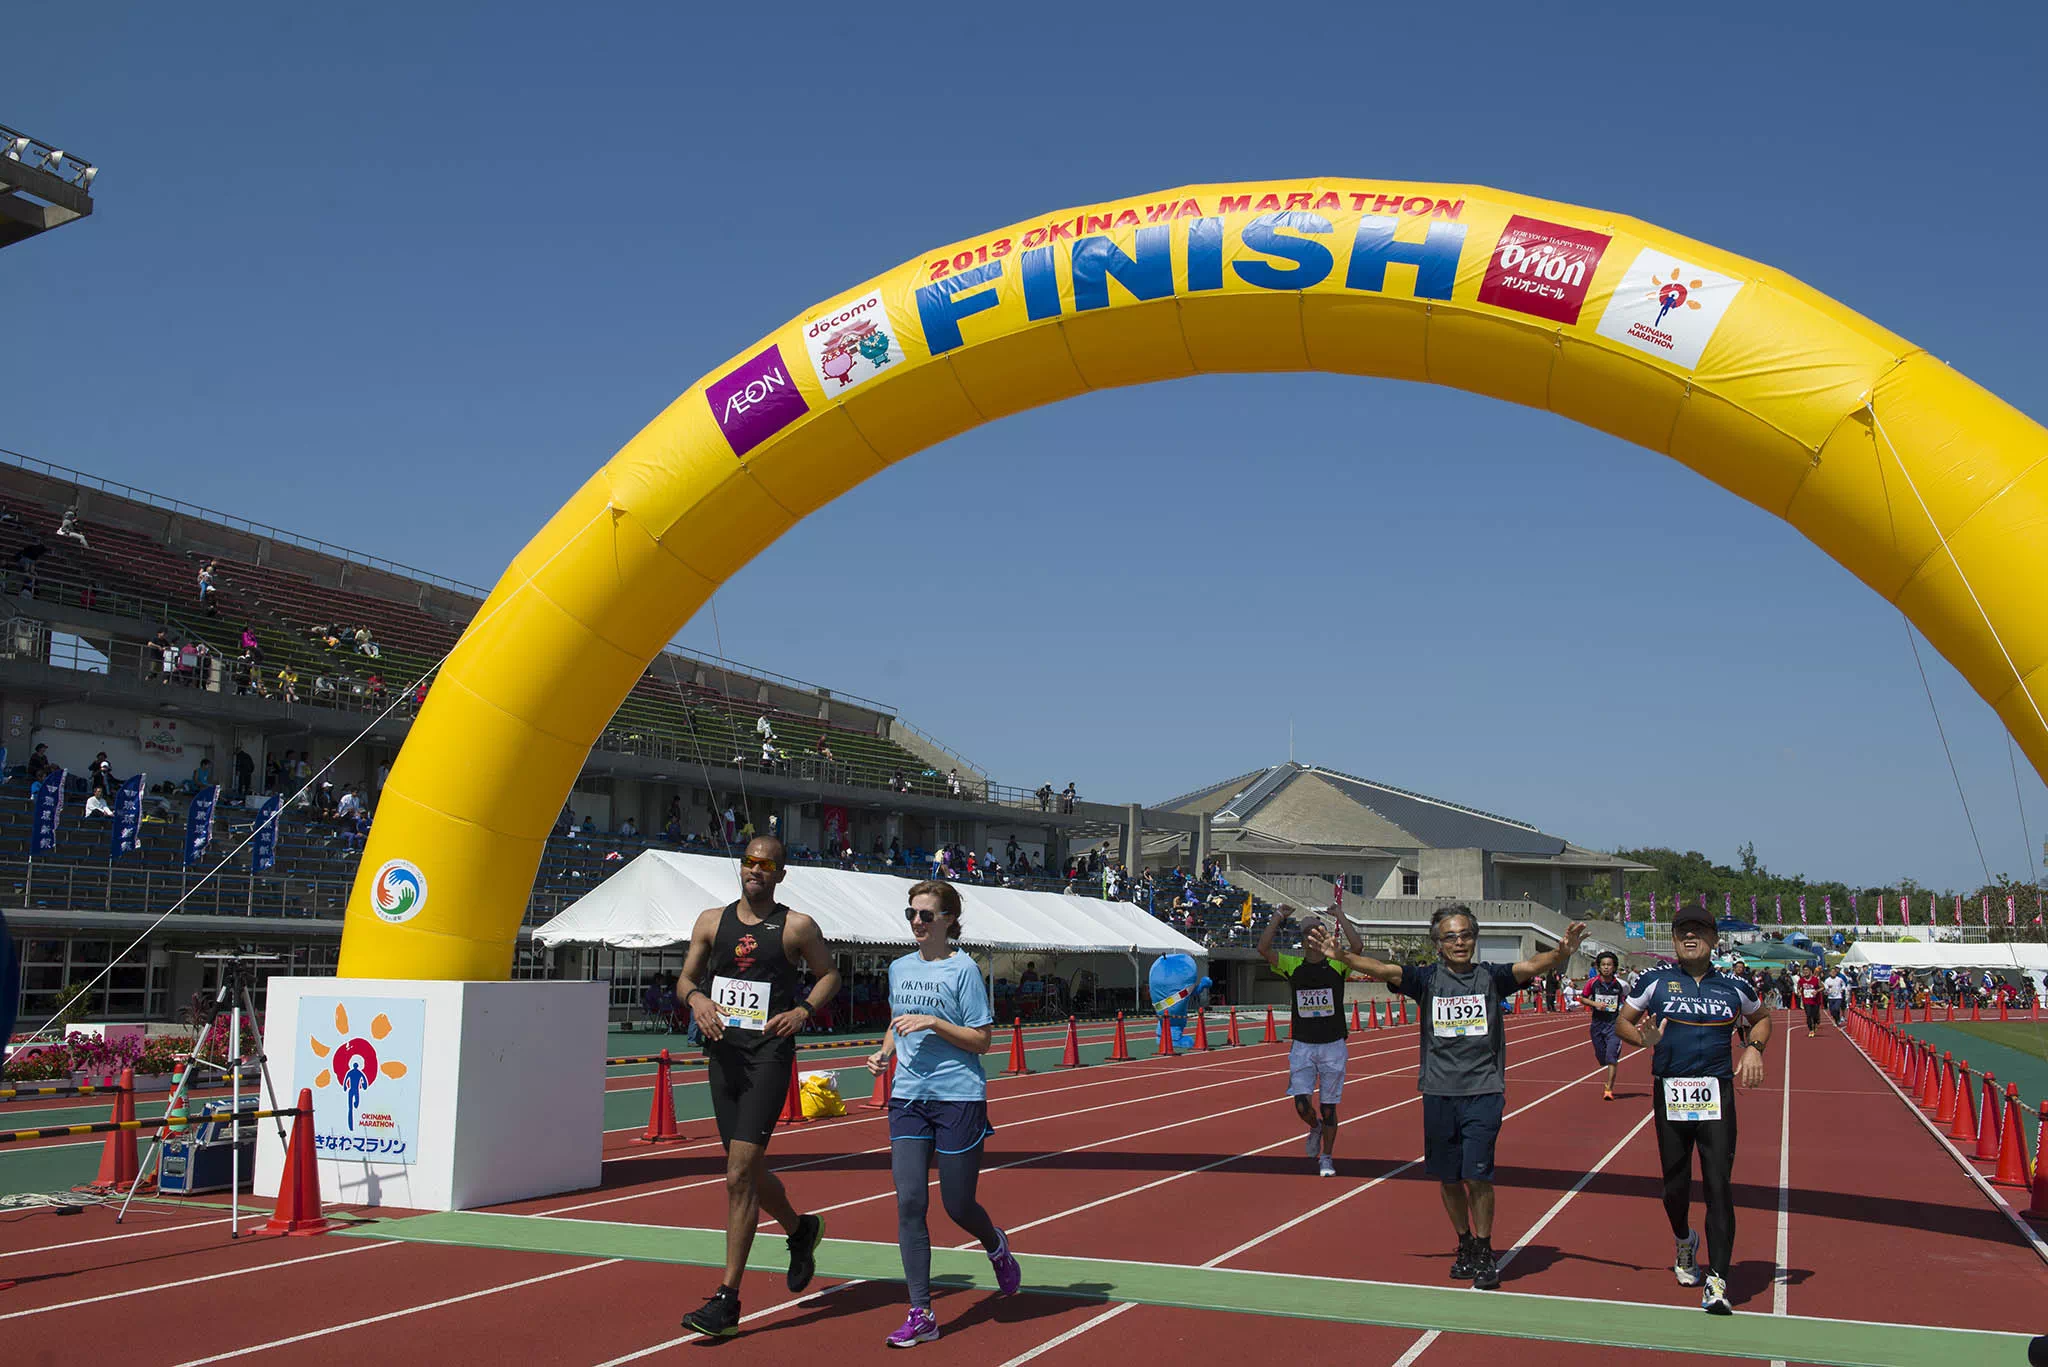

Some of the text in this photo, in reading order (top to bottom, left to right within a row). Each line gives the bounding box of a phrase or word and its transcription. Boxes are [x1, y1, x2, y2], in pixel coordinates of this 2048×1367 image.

[929, 191, 1465, 281] 2013 OKINAWA MARATHON
[1512, 229, 1528, 238] FOR
[1549, 237, 1573, 247] HAPPY
[1575, 243, 1595, 252] TIME
[915, 211, 1468, 357] FINISH
[1502, 276, 1565, 300] オリオンビール
[809, 298, 878, 338] docomo
[1627, 328, 1674, 350] MARATHON
[1633, 322, 1673, 342] OKINAWA
[719, 988, 760, 1009] 1312
[1302, 995, 1329, 1006] 2416
[1437, 996, 1480, 1006] オリオンビール
[1670, 996, 1728, 1006] RACING TEAM
[1437, 1004, 1484, 1020] 11392
[1663, 1001, 1734, 1018] ZANPA
[1671, 1088, 1712, 1103] 3140
[359, 1120, 395, 1129] MARATHON
[361, 1113, 392, 1121] OKINAWA
[315, 1134, 406, 1154] きなわマラソン
